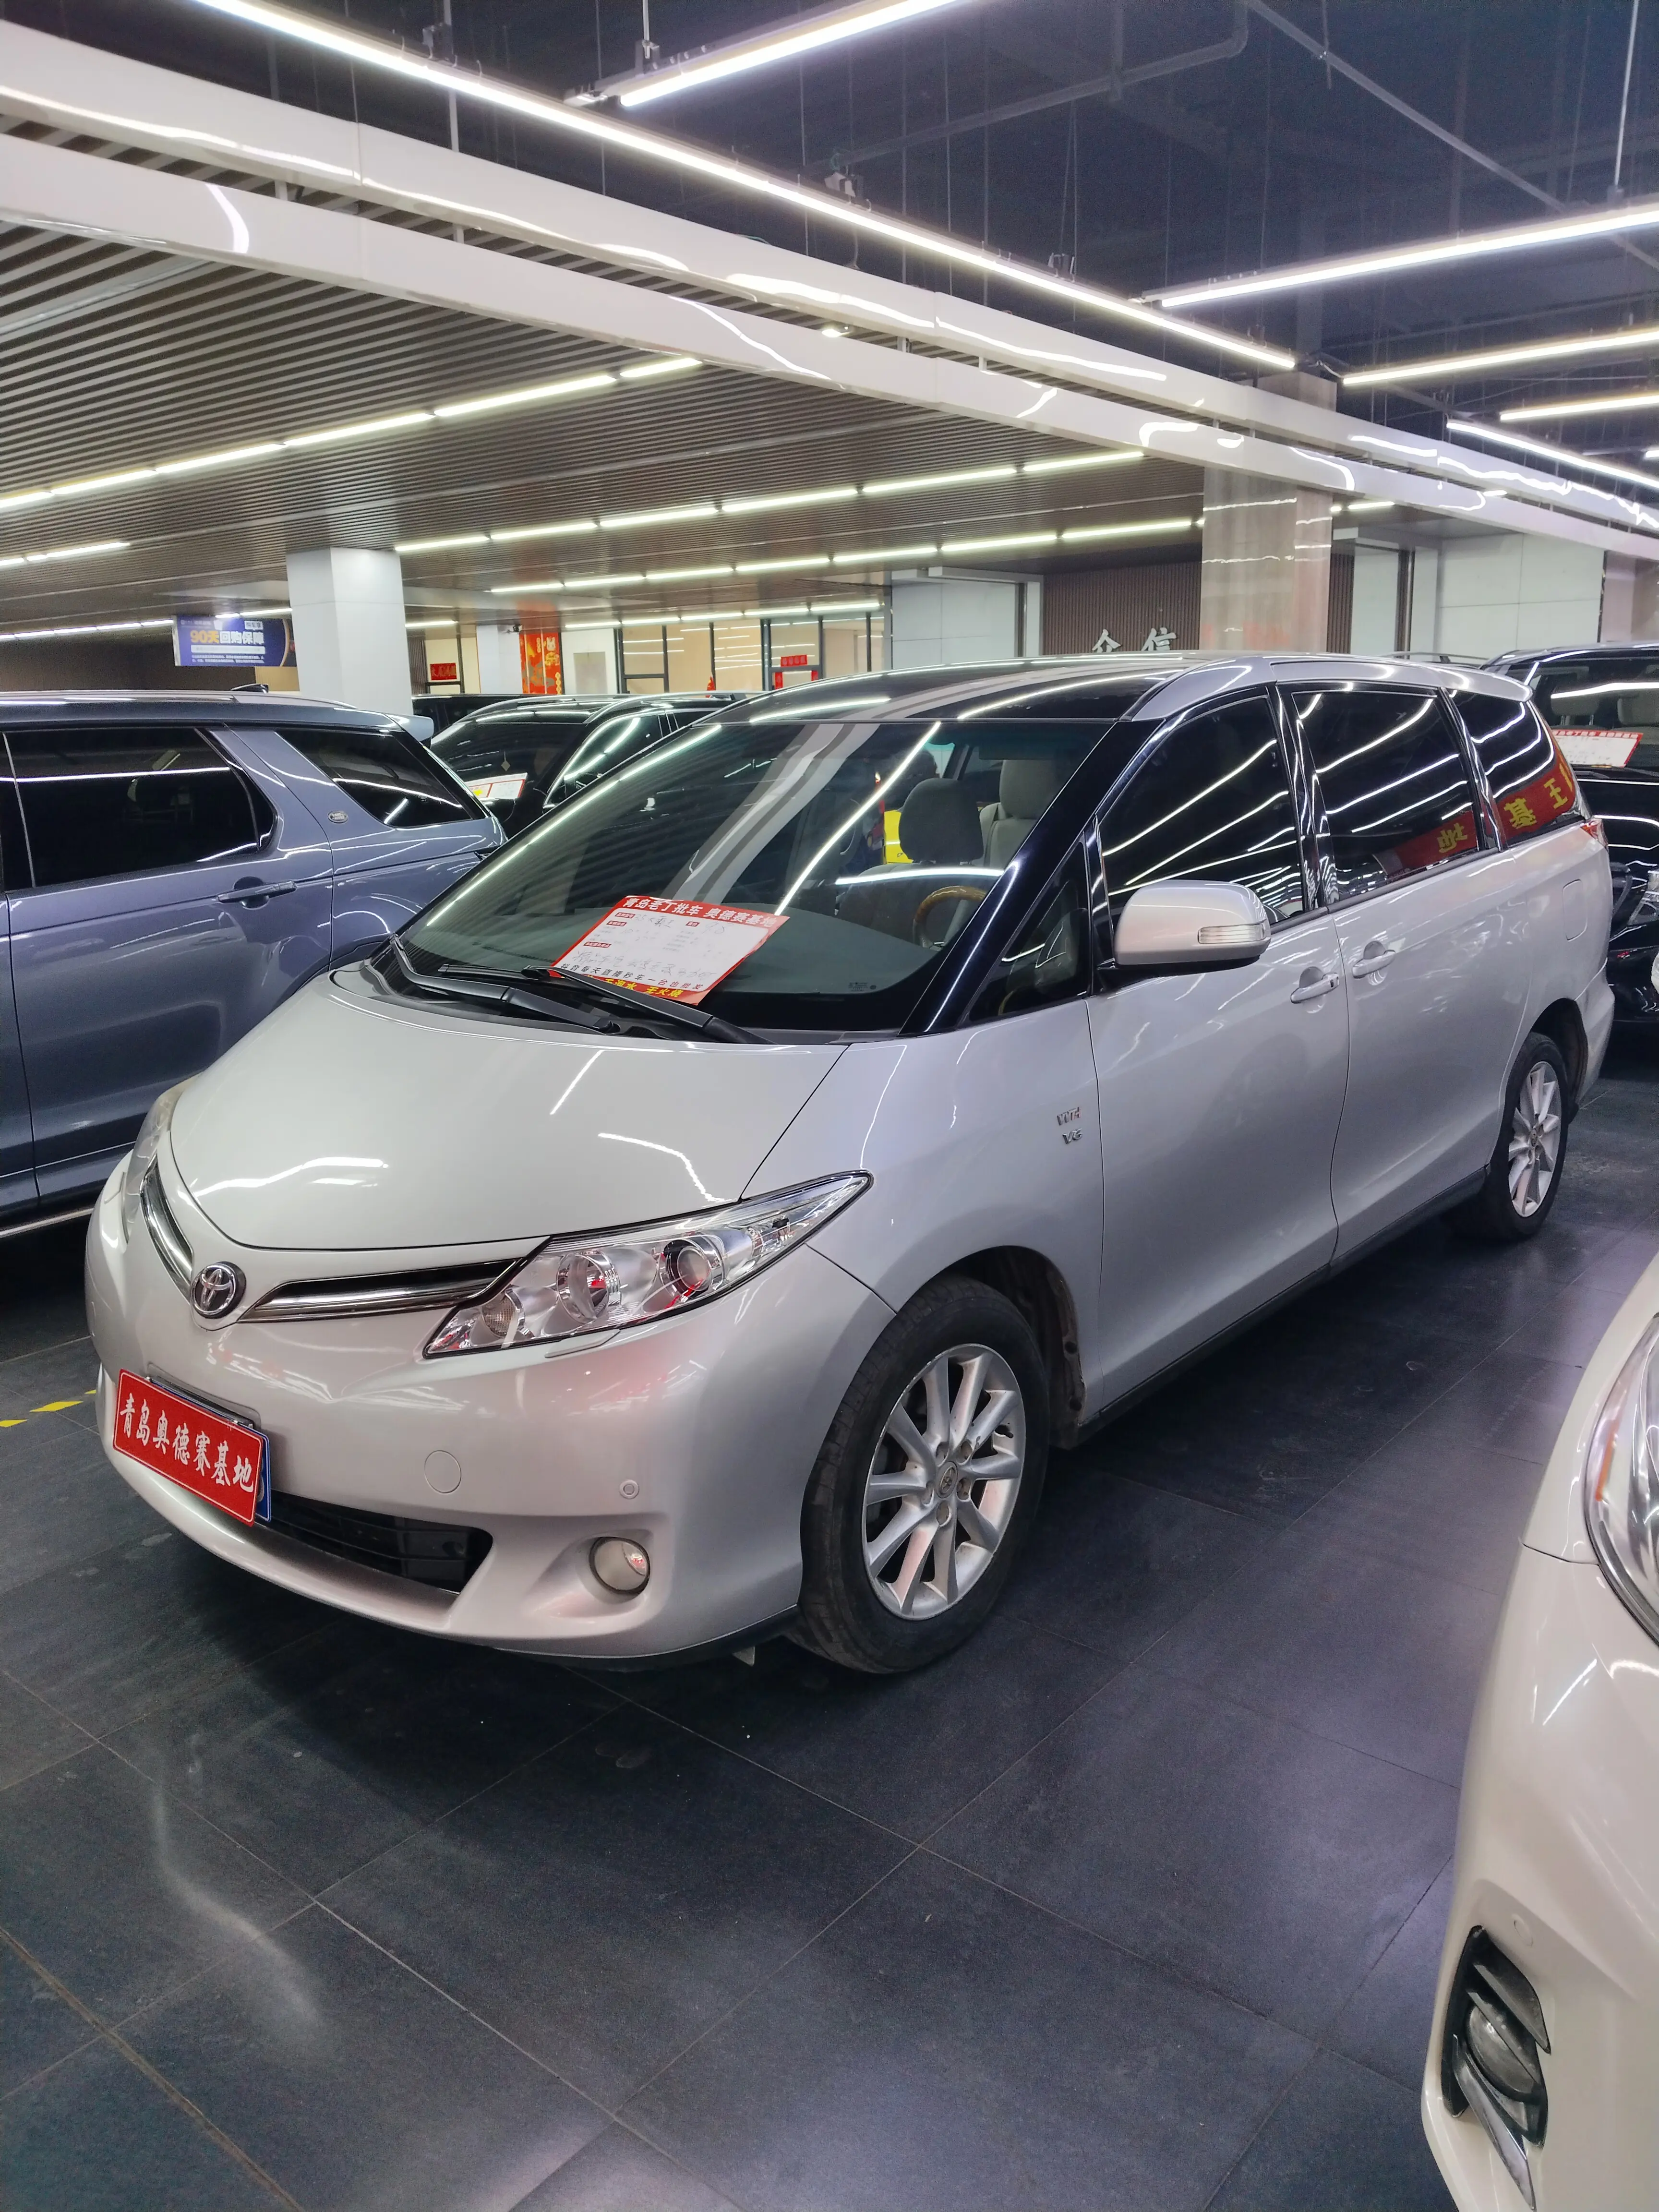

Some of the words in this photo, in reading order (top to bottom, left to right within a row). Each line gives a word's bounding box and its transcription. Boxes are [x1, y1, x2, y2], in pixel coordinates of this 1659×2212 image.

[190, 630, 264, 645] 90天回购保障
[622, 897, 703, 916] 青岛老丁批车
[703, 908, 777, 927] 奥德赛基地
[643, 986, 684, 998] 无火烧
[1062, 1127, 1083, 1144] V6
[120, 1392, 254, 1493] 青岛奥德赛基地
